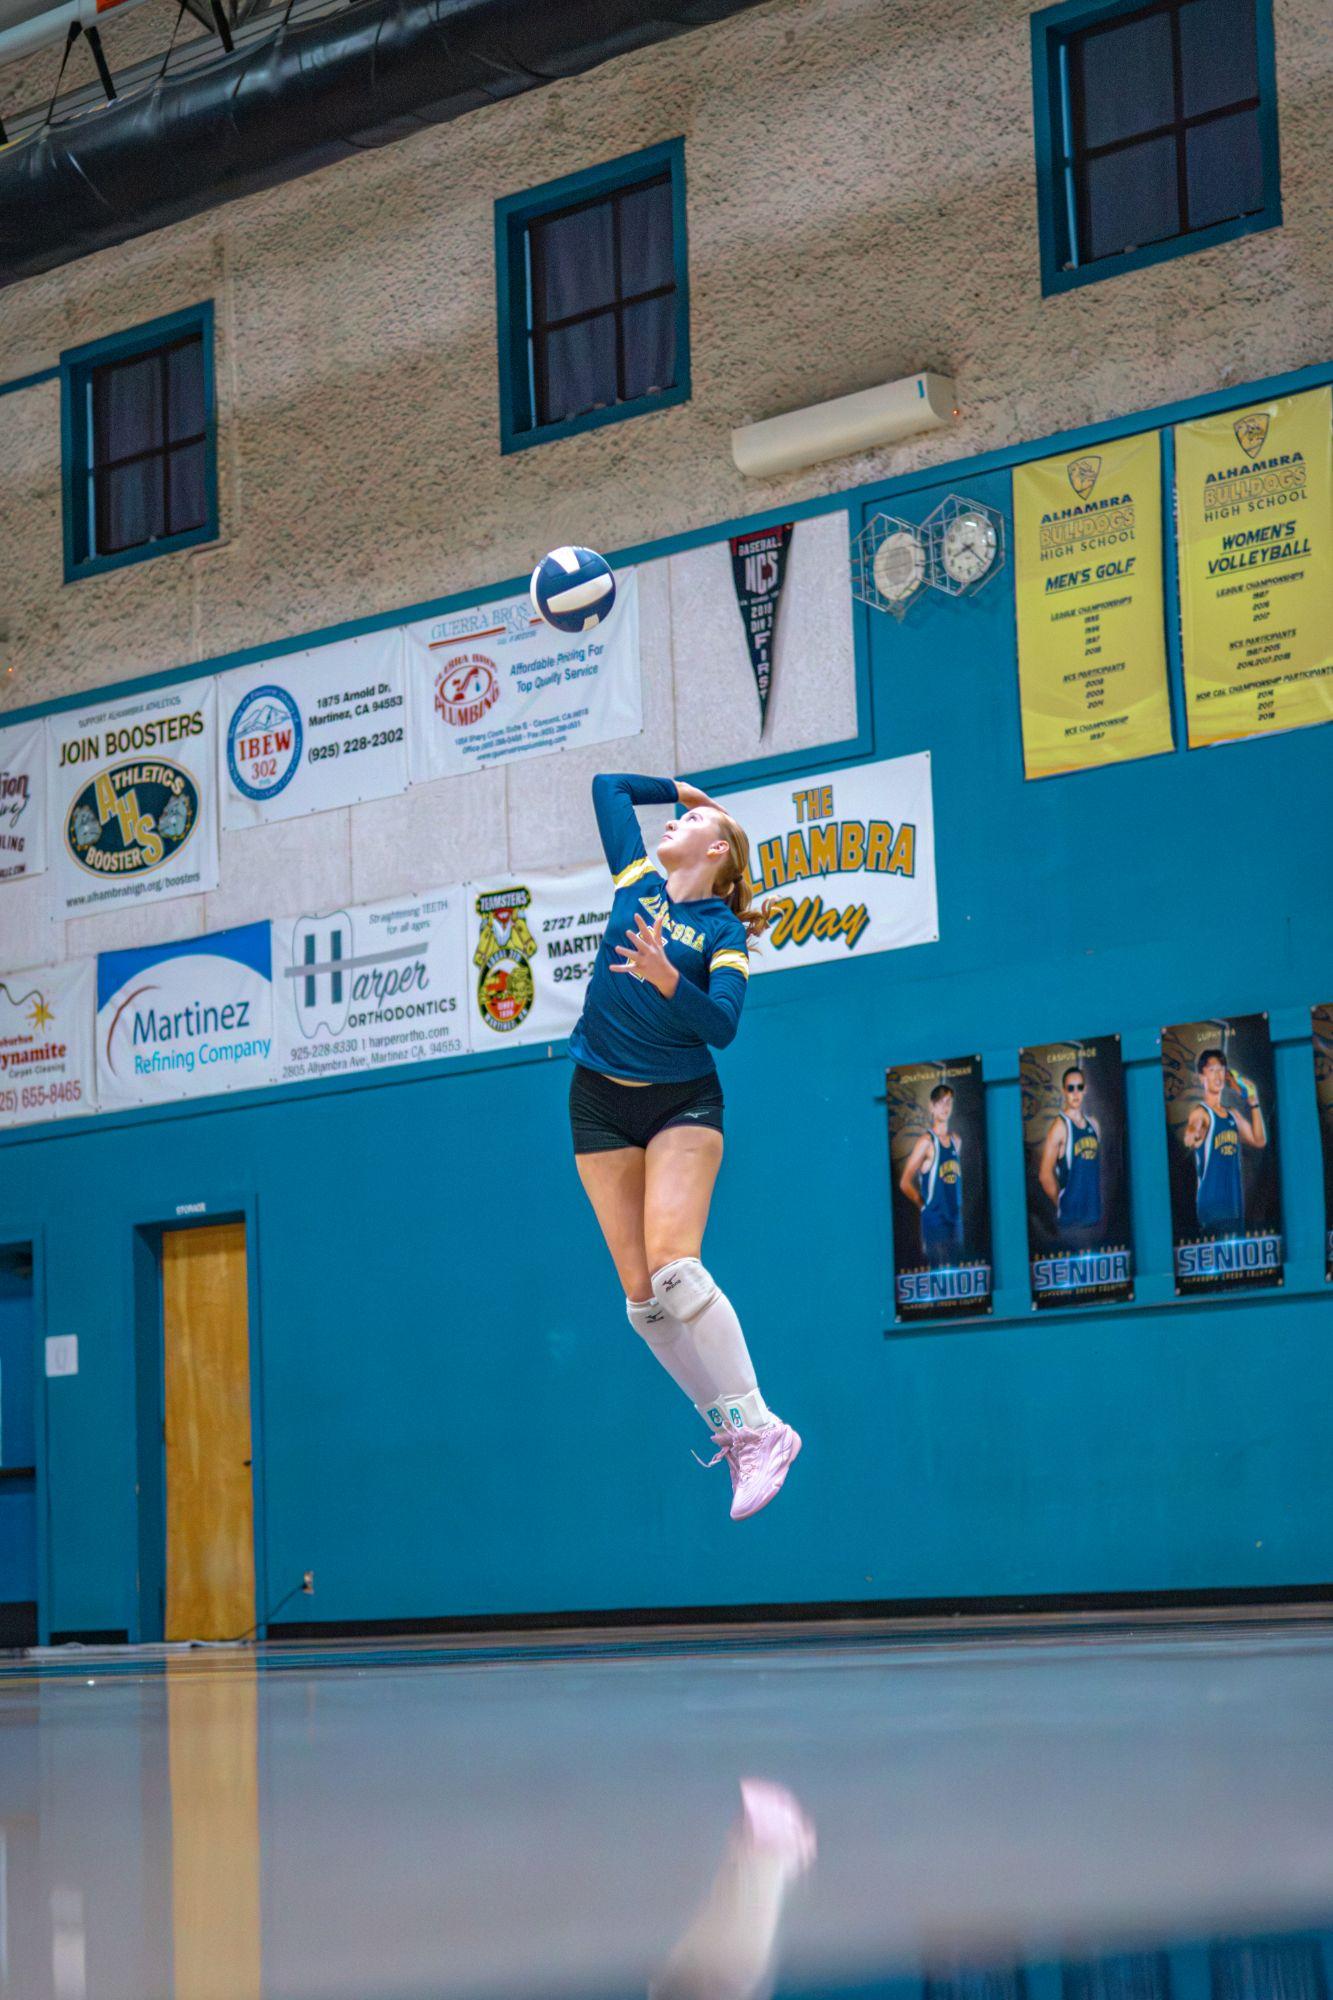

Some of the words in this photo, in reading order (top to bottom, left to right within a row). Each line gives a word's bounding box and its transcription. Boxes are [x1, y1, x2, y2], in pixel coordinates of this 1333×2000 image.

[1206, 452, 1304, 483] ALHAMBRA
[1204, 467, 1306, 509] BULLDOGS
[1041, 494, 1133, 524] ALHAMBRA
[1205, 506, 1240, 522] HIGH
[1248, 490, 1308, 512] SCHOOL
[1040, 509, 1135, 549] BULLDOGS
[1222, 520, 1296, 550] WOMEN'S
[1040, 548, 1074, 562] HIGH
[1081, 530, 1135, 551] SCHOOL
[1208, 538, 1312, 574] VOLLEYBALL
[1045, 568, 1092, 592] MEN'S
[1096, 557, 1136, 579] GOLF
[509, 655, 556, 676] Affordable
[587, 643, 604, 657] For
[516, 680, 533, 694] Top
[534, 671, 562, 690] Quality
[564, 664, 598, 681] Service
[317, 694, 340, 709] 1875
[343, 685, 375, 703] Arnold
[354, 703, 369, 716] CA
[372, 695, 403, 712] 94553
[434, 681, 500, 727] PLUMBING
[59, 736, 99, 767] JOIN
[106, 711, 204, 757] BOOSTERS
[239, 729, 292, 762] IBEW
[308, 742, 340, 764] (925)
[343, 728, 404, 754] 228-2302
[251, 758, 277, 780] 302
[792, 784, 834, 824] THE
[744, 819, 916, 899] LHAMBRA
[480, 890, 527, 912] TEAMSTERS
[543, 915, 574, 932] 2727
[768, 894, 870, 951] Way
[547, 934, 603, 959] MARTI
[284, 930, 429, 1009] Harper
[133, 1001, 250, 1046] Martinez
[348, 998, 457, 1028] ORTHODONTICS
[368, 1026, 450, 1048] harperortho.com
[0, 1042, 66, 1071] ynamite
[134, 1050, 195, 1075] Refining
[199, 1038, 271, 1064] Company
[307, 1056, 348, 1075] Alhambra
[0, 1088, 18, 1112] 25)
[1034, 1251, 1130, 1290] SENIOR
[1177, 1237, 1280, 1277] SENIOR
[897, 1266, 990, 1303] SENIOR
